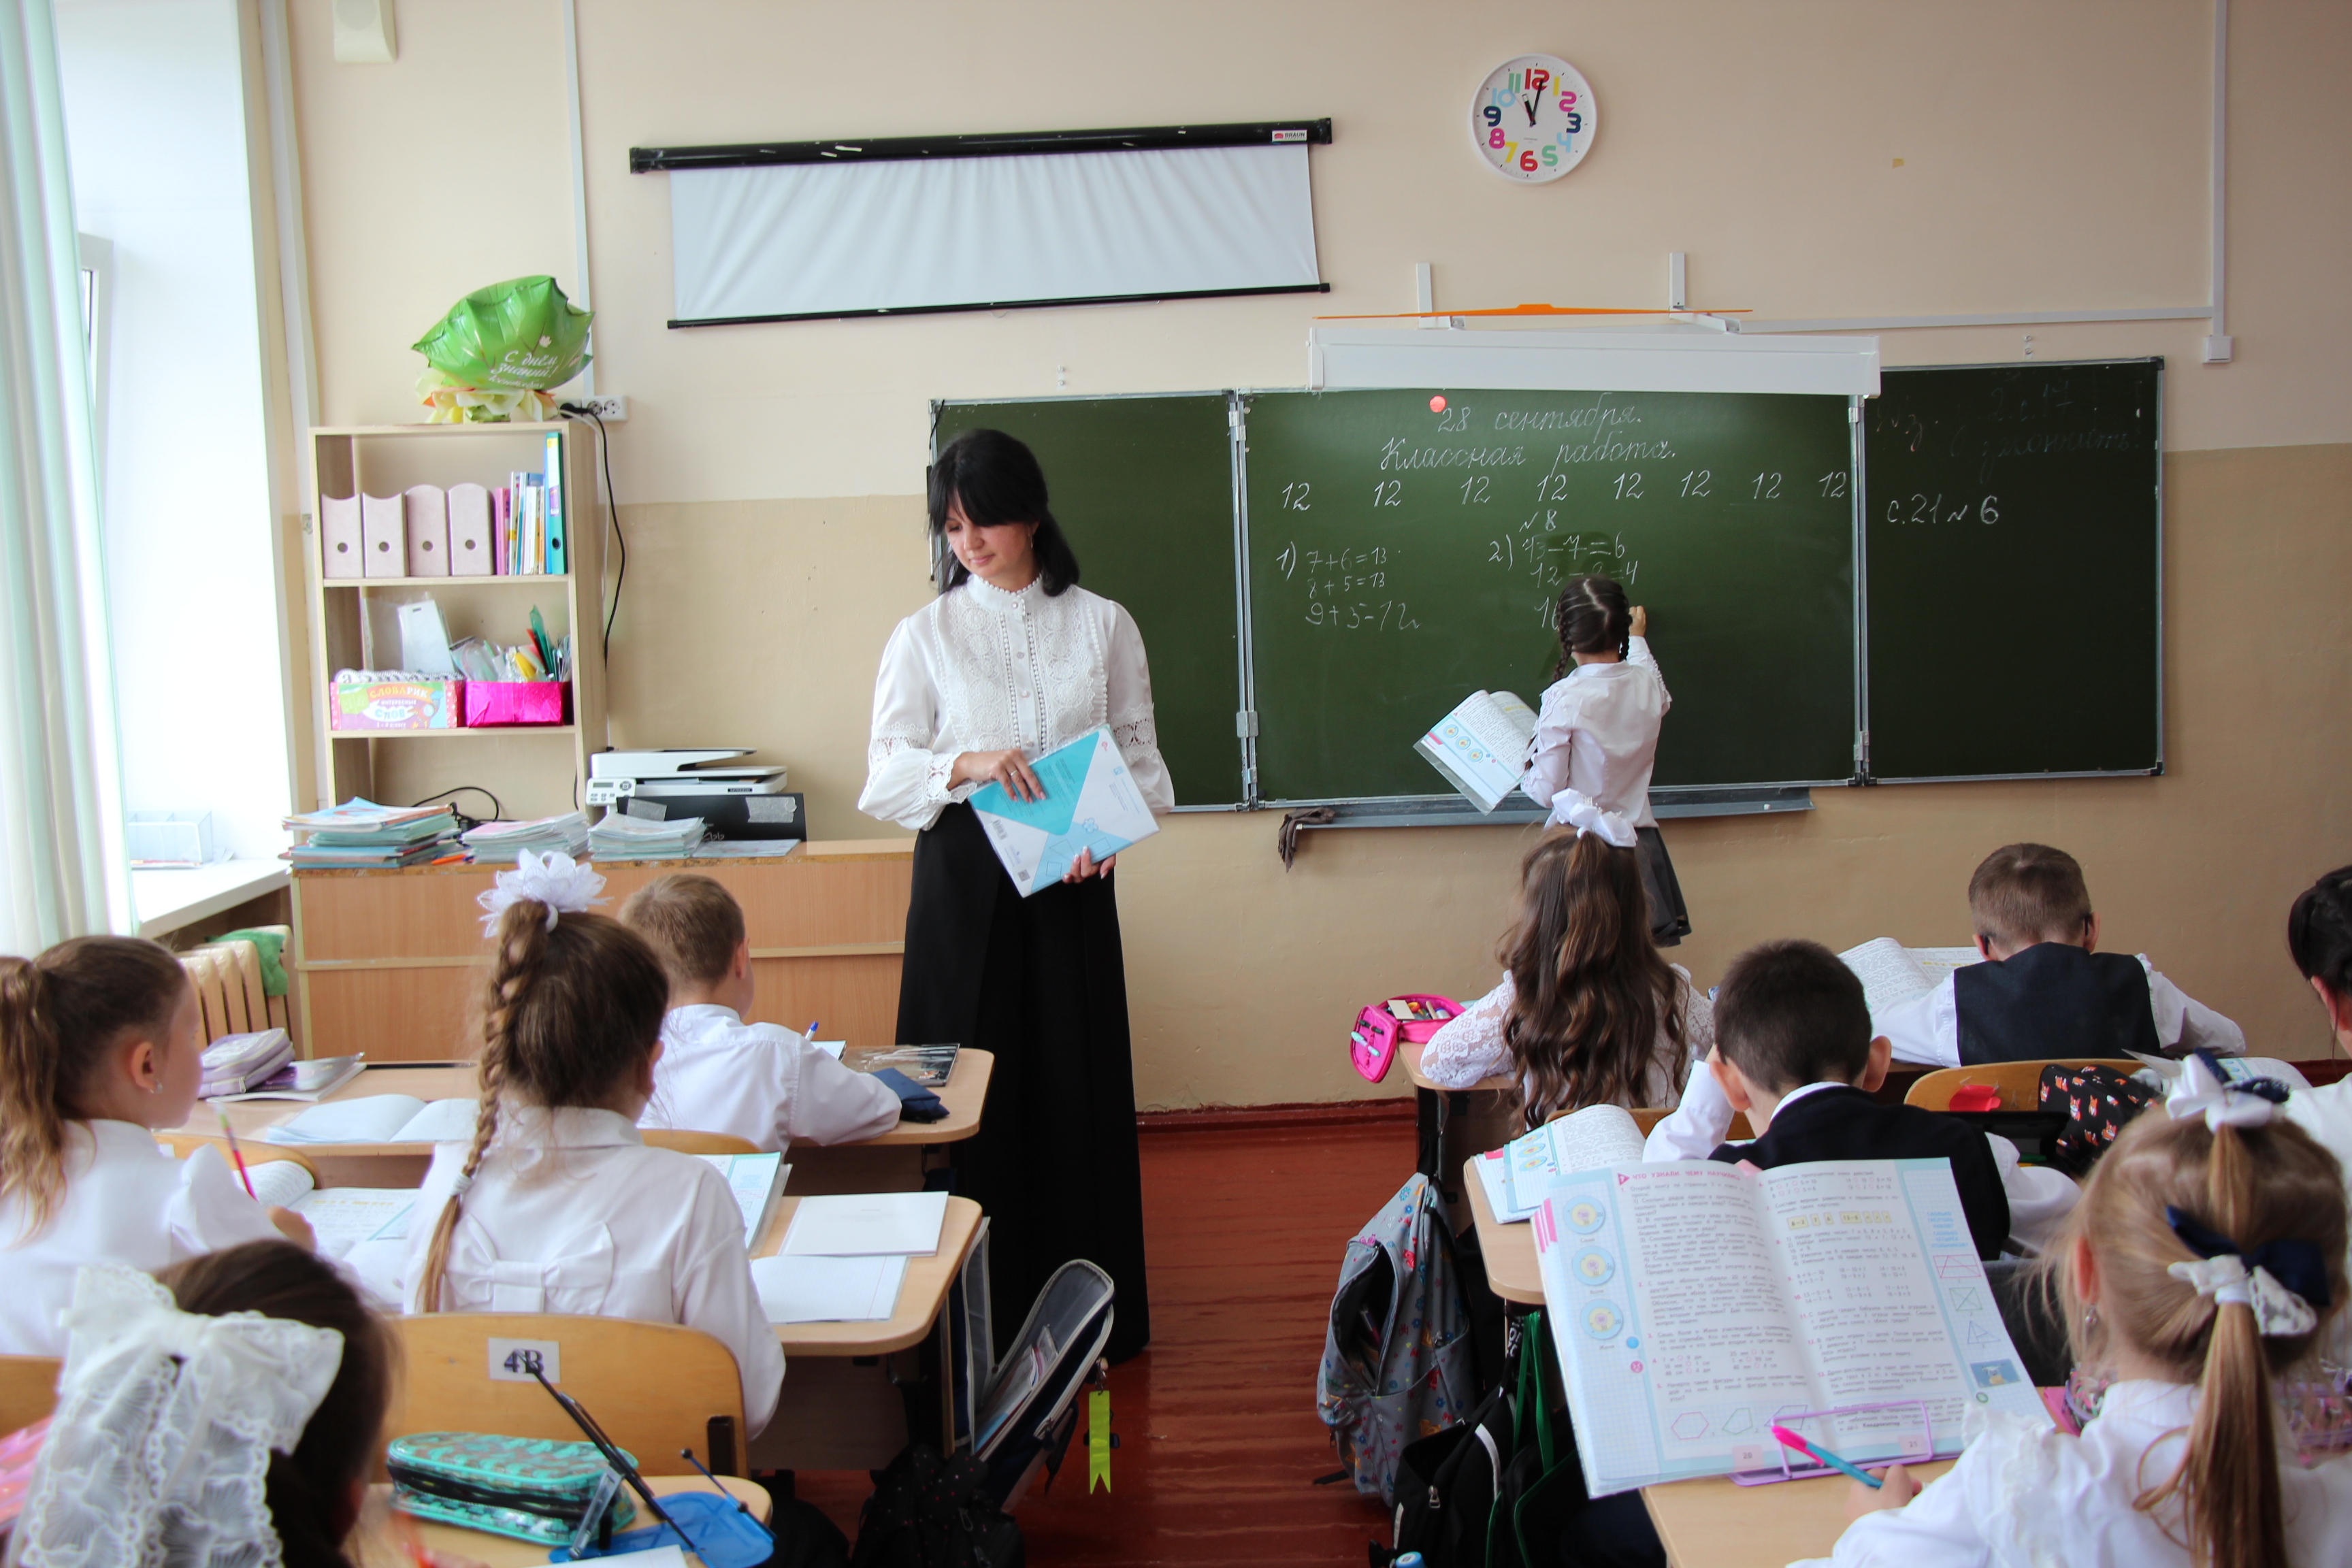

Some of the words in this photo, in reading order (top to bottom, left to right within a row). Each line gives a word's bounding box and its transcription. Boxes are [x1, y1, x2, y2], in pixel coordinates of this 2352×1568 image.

[1508, 73, 1522, 93] 11
[1524, 68, 1550, 91] 12
[1552, 76, 1561, 97] 1
[1490, 87, 1516, 108] 10
[1558, 91, 1577, 112] 2
[1483, 105, 1502, 127] 9
[1566, 112, 1582, 133] 3
[1488, 127, 1505, 149] 8
[1556, 132, 1573, 153] 4
[1504, 142, 1519, 163] 7
[1520, 150, 1538, 172] 6
[1541, 144, 1558, 167] 5
[1437, 406, 1471, 432] 28
[1380, 437, 1526, 471] Классная
[1550, 431, 1676, 477] работа.
[1281, 482, 1311, 511] 12
[1374, 480, 1402, 507] 12
[1460, 476, 1490, 505] 12
[1537, 474, 1567, 502] 12
[1614, 472, 1644, 500] 12
[1680, 470, 1711, 497] 12
[1751, 472, 1782, 500] 12
[1818, 471, 1847, 499] 12
[1545, 509, 1557, 532] 8
[1980, 495, 1999, 524] 6
[1276, 541, 1296, 581] 1)
[1488, 534, 1513, 571] 2)
[370, 686, 428, 698] СЛОВАРИК
[1708, 1171, 1740, 1181] НАУЧИЛИСЬ
